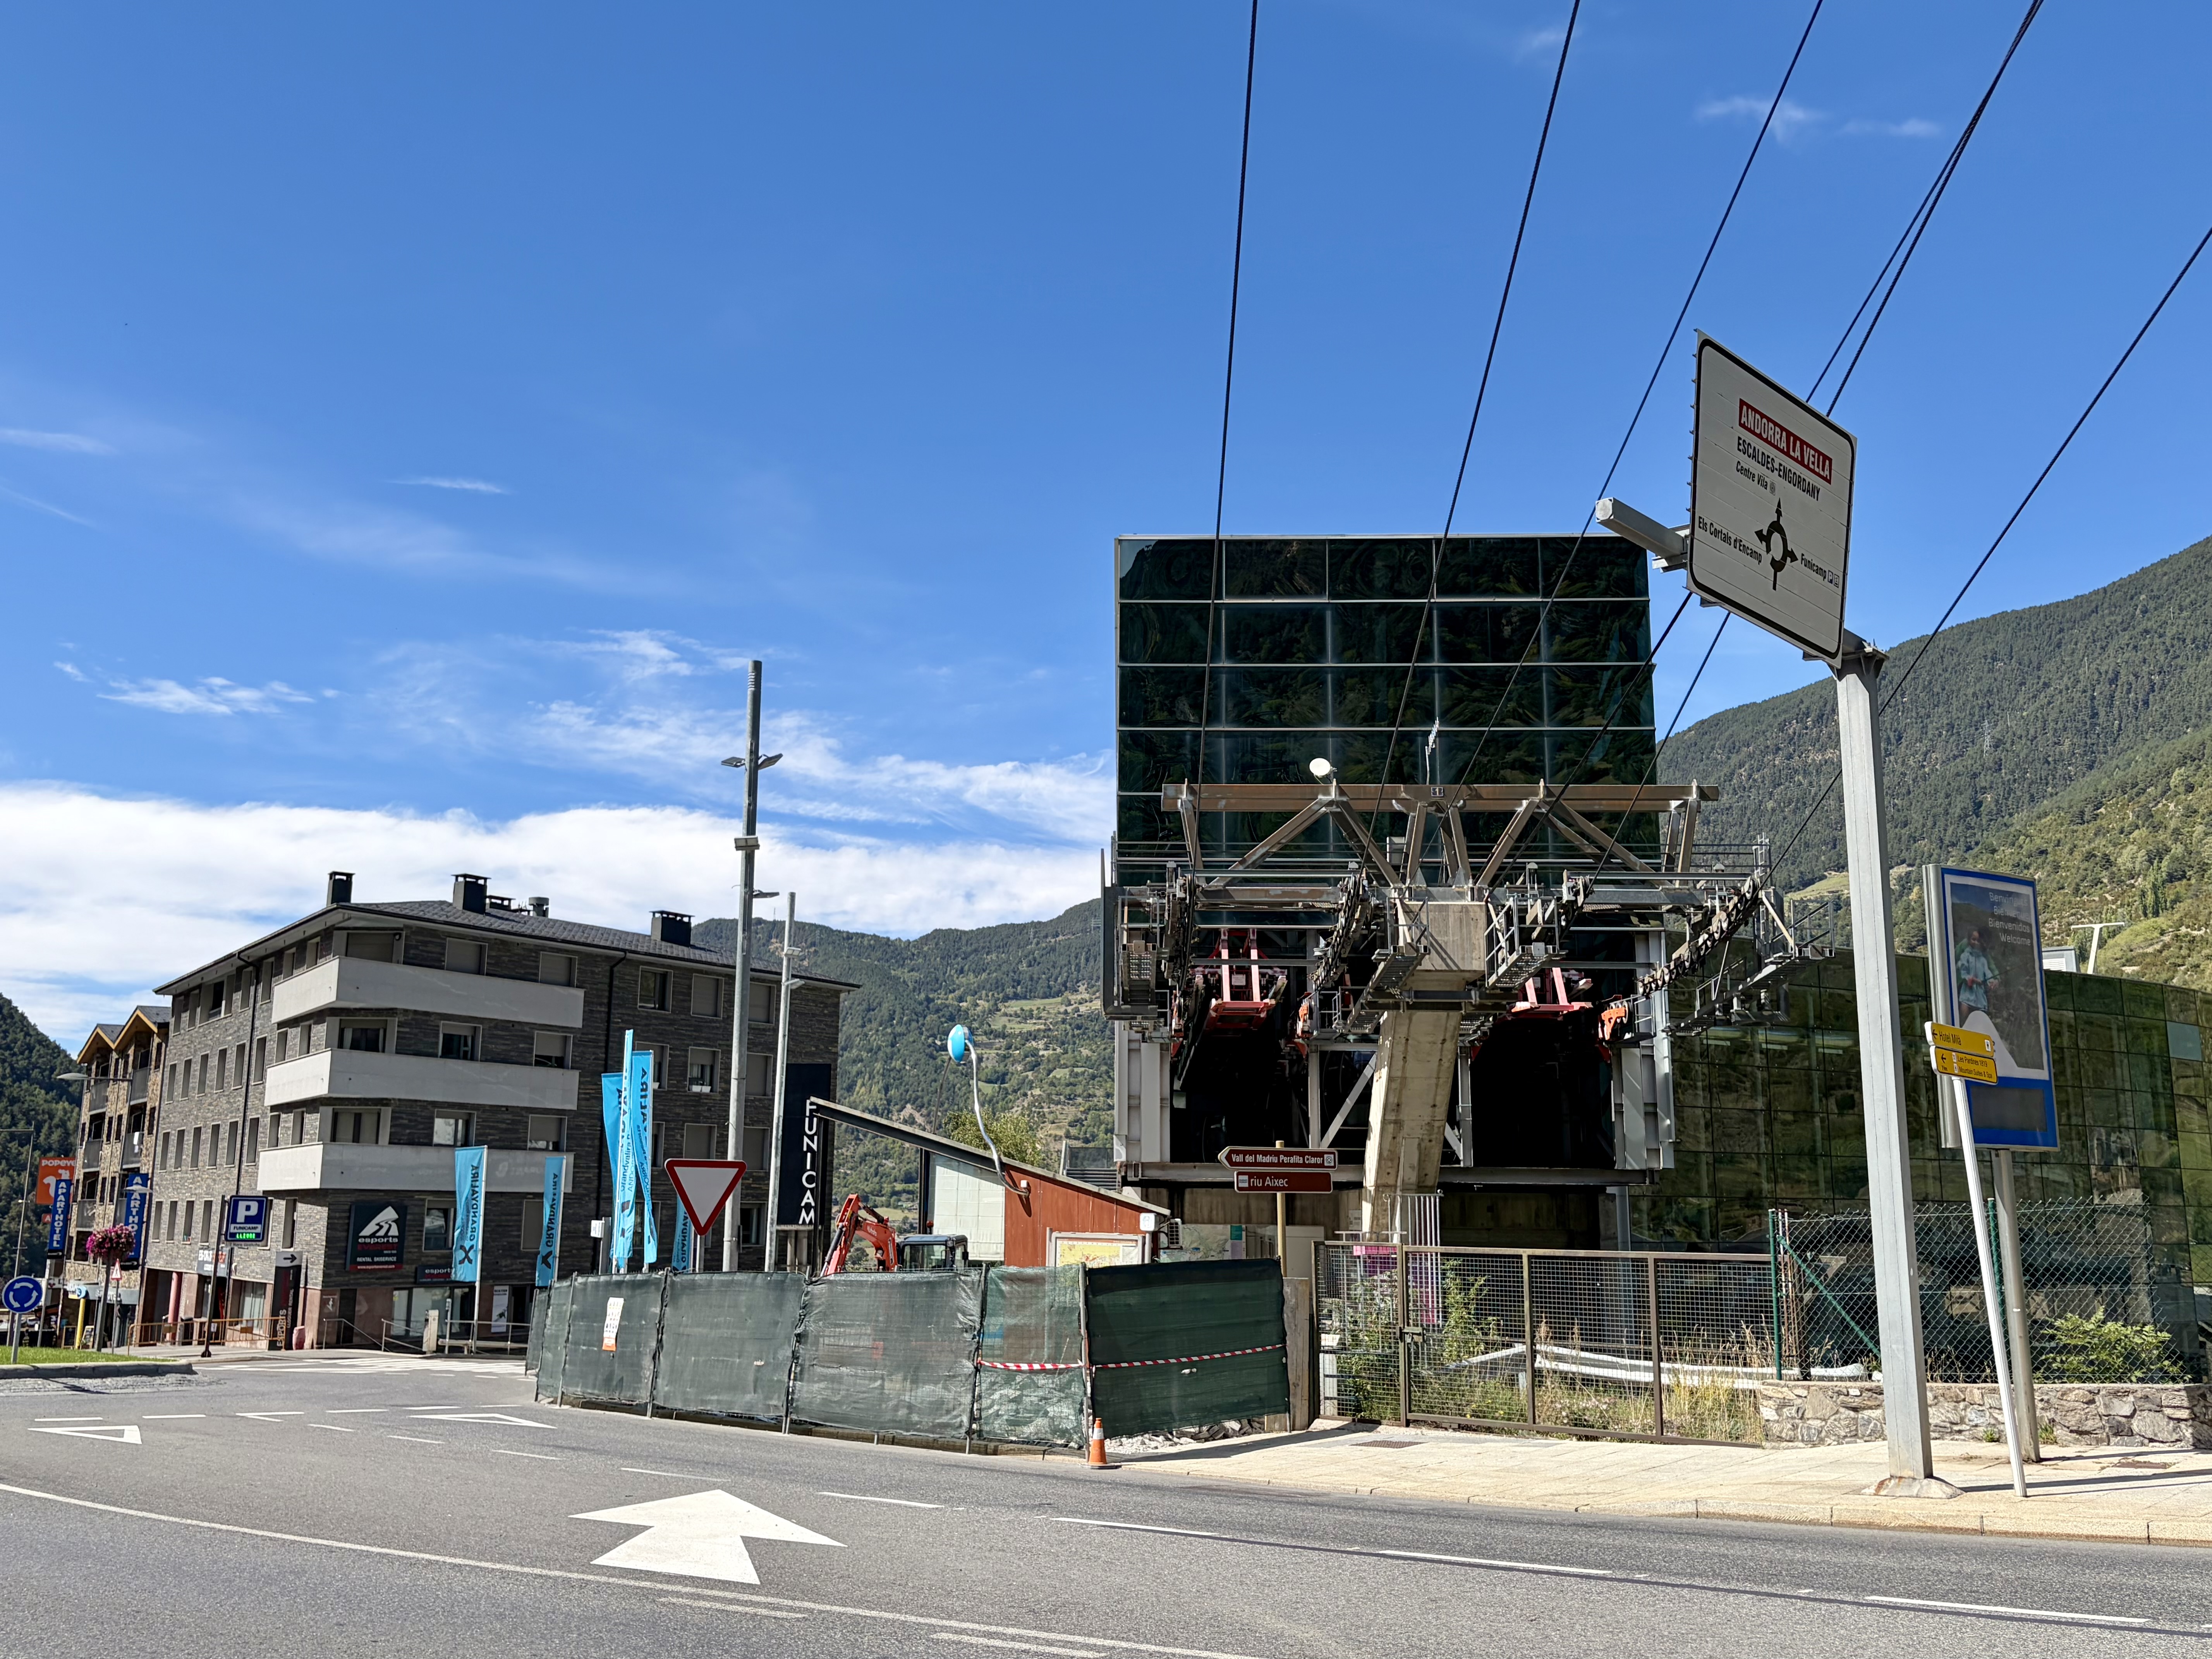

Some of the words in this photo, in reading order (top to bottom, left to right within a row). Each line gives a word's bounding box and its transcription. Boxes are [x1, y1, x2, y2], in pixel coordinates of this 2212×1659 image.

[1741, 405, 1787, 452] ANDORRA
[1790, 436, 1801, 461] LA
[1803, 445, 1830, 479] VELLA
[1736, 460, 1755, 482] Centre
[1758, 473, 1768, 490] Vila
[1737, 436, 1820, 501] ESCALDES-ENGORDANY
[1698, 516, 1707, 532] Els
[1709, 522, 1731, 546] Cortals
[1734, 537, 1762, 565] d'Encamp
[1801, 553, 1827, 581] Funicamp
[1989, 918, 2030, 933] Bienvenidos
[2000, 933, 2031, 946] Welcome
[1939, 1030, 1951, 1043] Hotel
[799, 1099, 817, 1224] FUNICAM
[1231, 1154, 1243, 1162] Vall
[1245, 1154, 1254, 1162] del
[1257, 1154, 1278, 1163] Madriu
[1279, 1154, 1303, 1163] Perafita
[1305, 1156, 1323, 1164] Claror
[1250, 1176, 1262, 1187] riu
[1265, 1176, 1288, 1187] Aixec
[53, 1182, 67, 1247] APARTHOTEL
[237, 1200, 258, 1223] P
